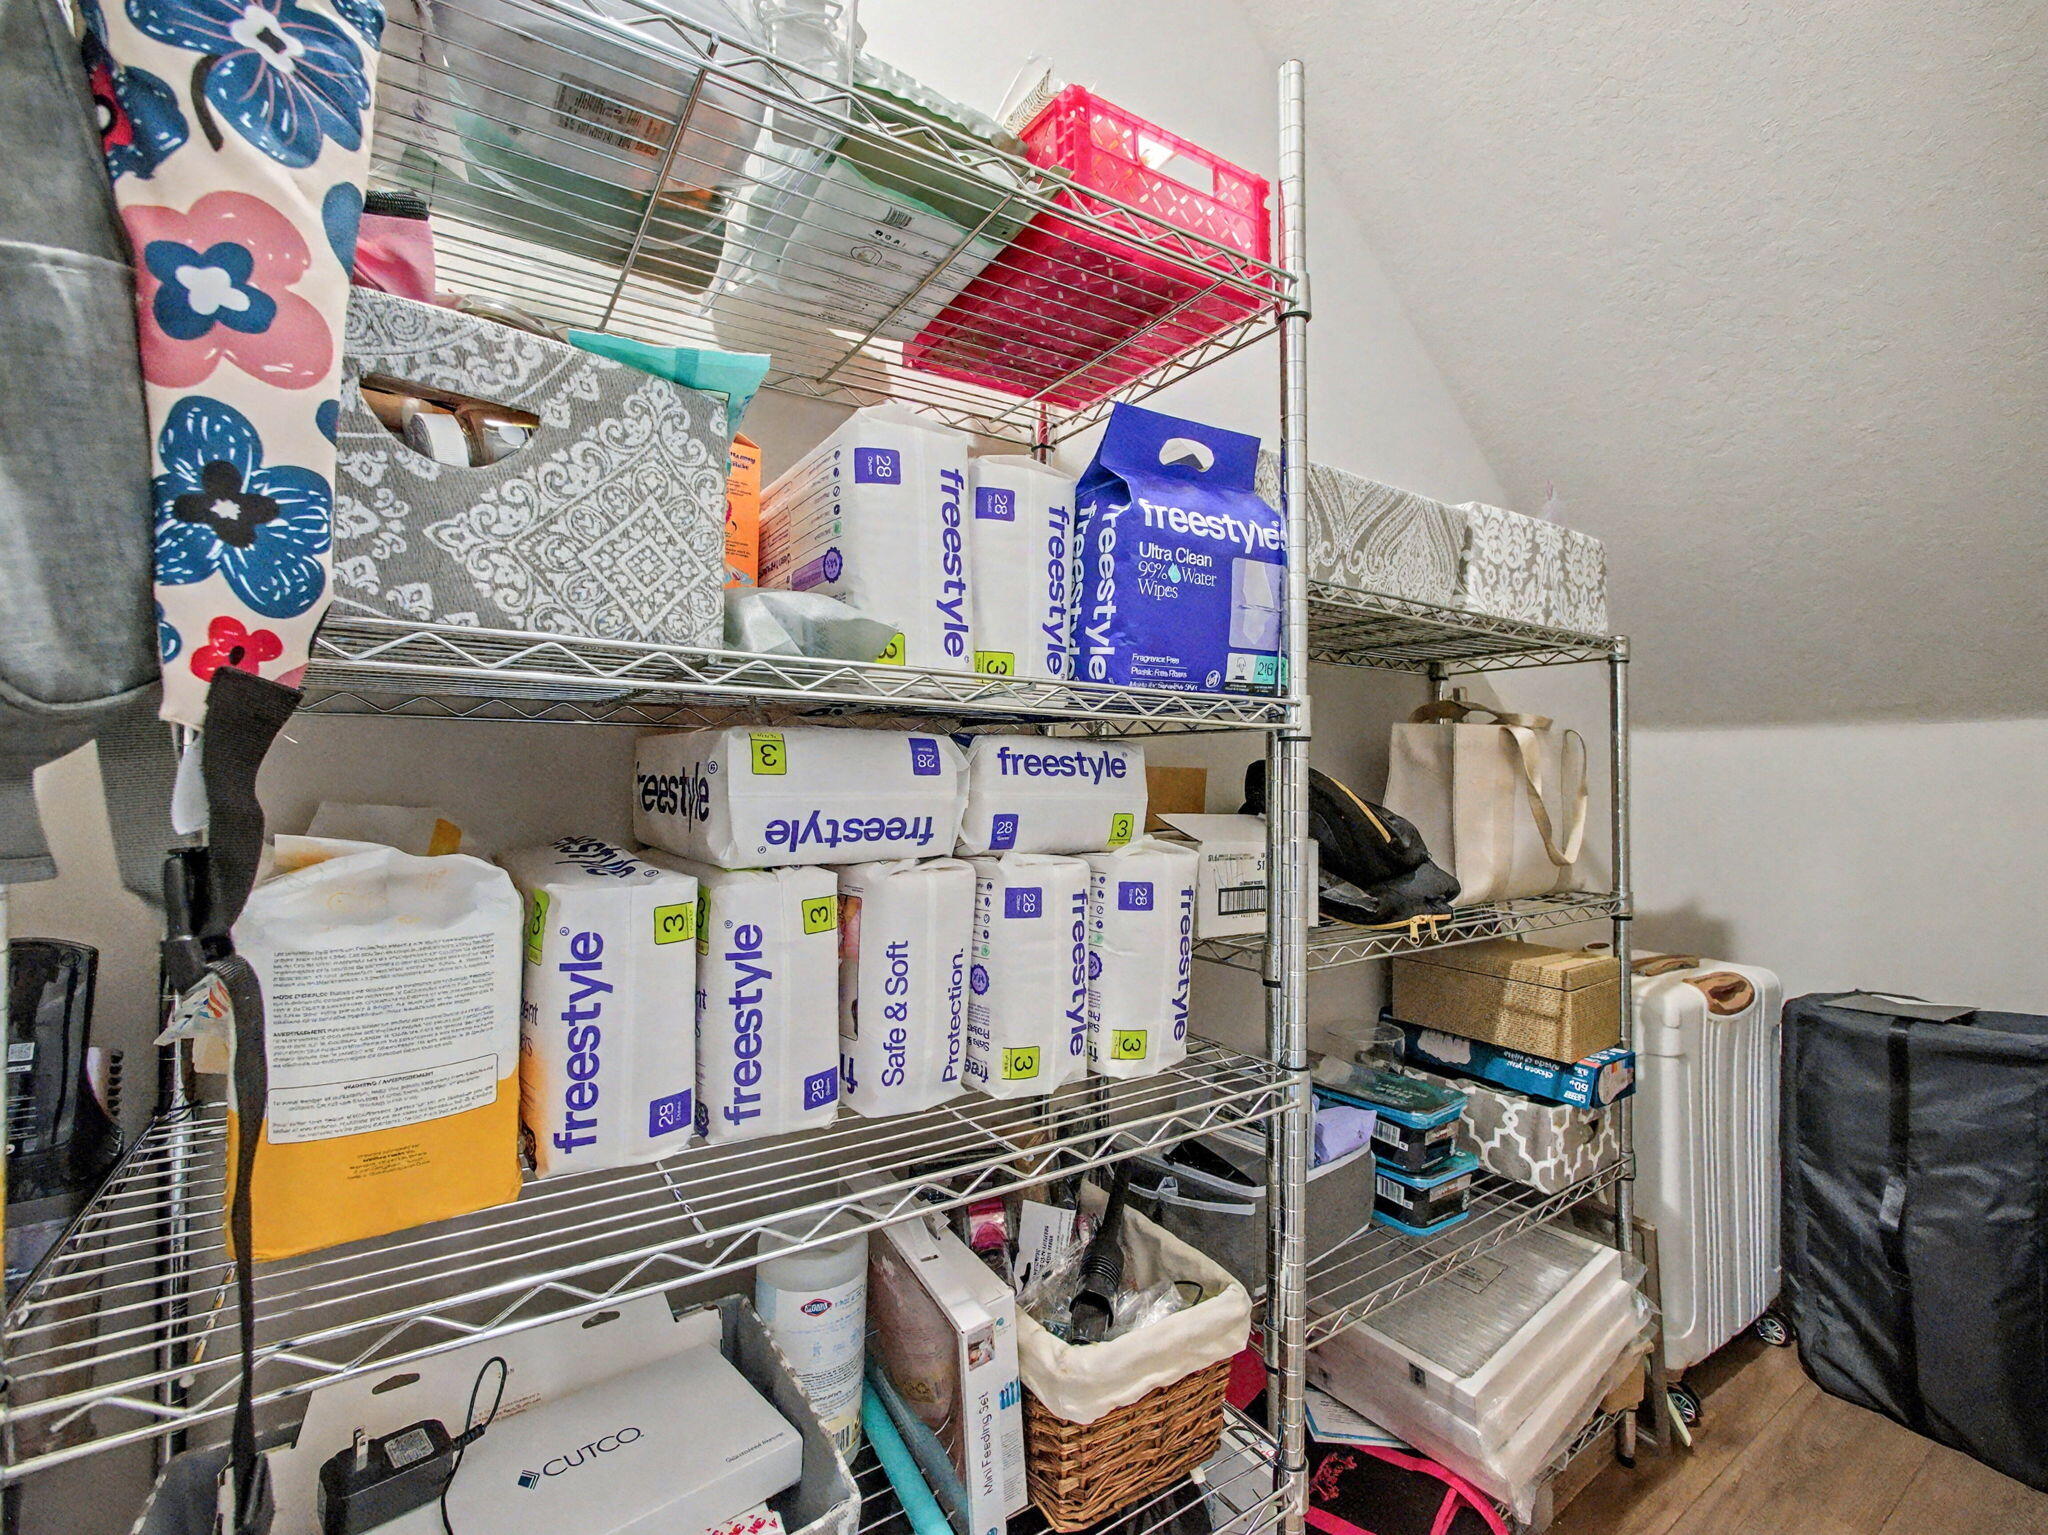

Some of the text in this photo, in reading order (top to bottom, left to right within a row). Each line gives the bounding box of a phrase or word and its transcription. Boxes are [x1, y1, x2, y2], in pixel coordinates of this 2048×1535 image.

[876, 455, 892, 478] 28
[994, 494, 1008, 515] 28
[1138, 498, 1283, 553] freestyle
[936, 468, 969, 658] freestyle
[1138, 542, 1212, 567] Ultra Clean
[1138, 561, 1217, 587] 99% Water
[1042, 505, 1070, 675] freestyle
[1085, 502, 1131, 680] freestyle
[1137, 578, 1179, 600] Wipes
[986, 659, 1008, 675] 3
[1257, 662, 1274, 676] 216
[760, 744, 778, 767] 3
[917, 754, 935, 768] 28
[997, 747, 1126, 785] freestyle
[765, 810, 934, 852] freestyle
[996, 821, 1013, 835] 28
[1116, 820, 1128, 838] 3
[1022, 893, 1036, 913] 28
[1134, 888, 1148, 906] 28
[663, 914, 685, 933] 3
[810, 906, 829, 924] 3
[1065, 889, 1089, 1056] freestyle
[1172, 885, 1194, 1041] freestyle
[723, 924, 773, 1126] freestyle
[881, 940, 909, 1087] Safe & Soft
[942, 948, 964, 1083] Protection.
[553, 931, 613, 1154] freestyle
[1123, 1038, 1141, 1051] 3
[1014, 1056, 1034, 1071] 3
[811, 1078, 825, 1103] 28
[658, 1102, 674, 1128] 28
[543, 1427, 641, 1477] CUTCO
[981, 1413, 993, 1468] Feeding
